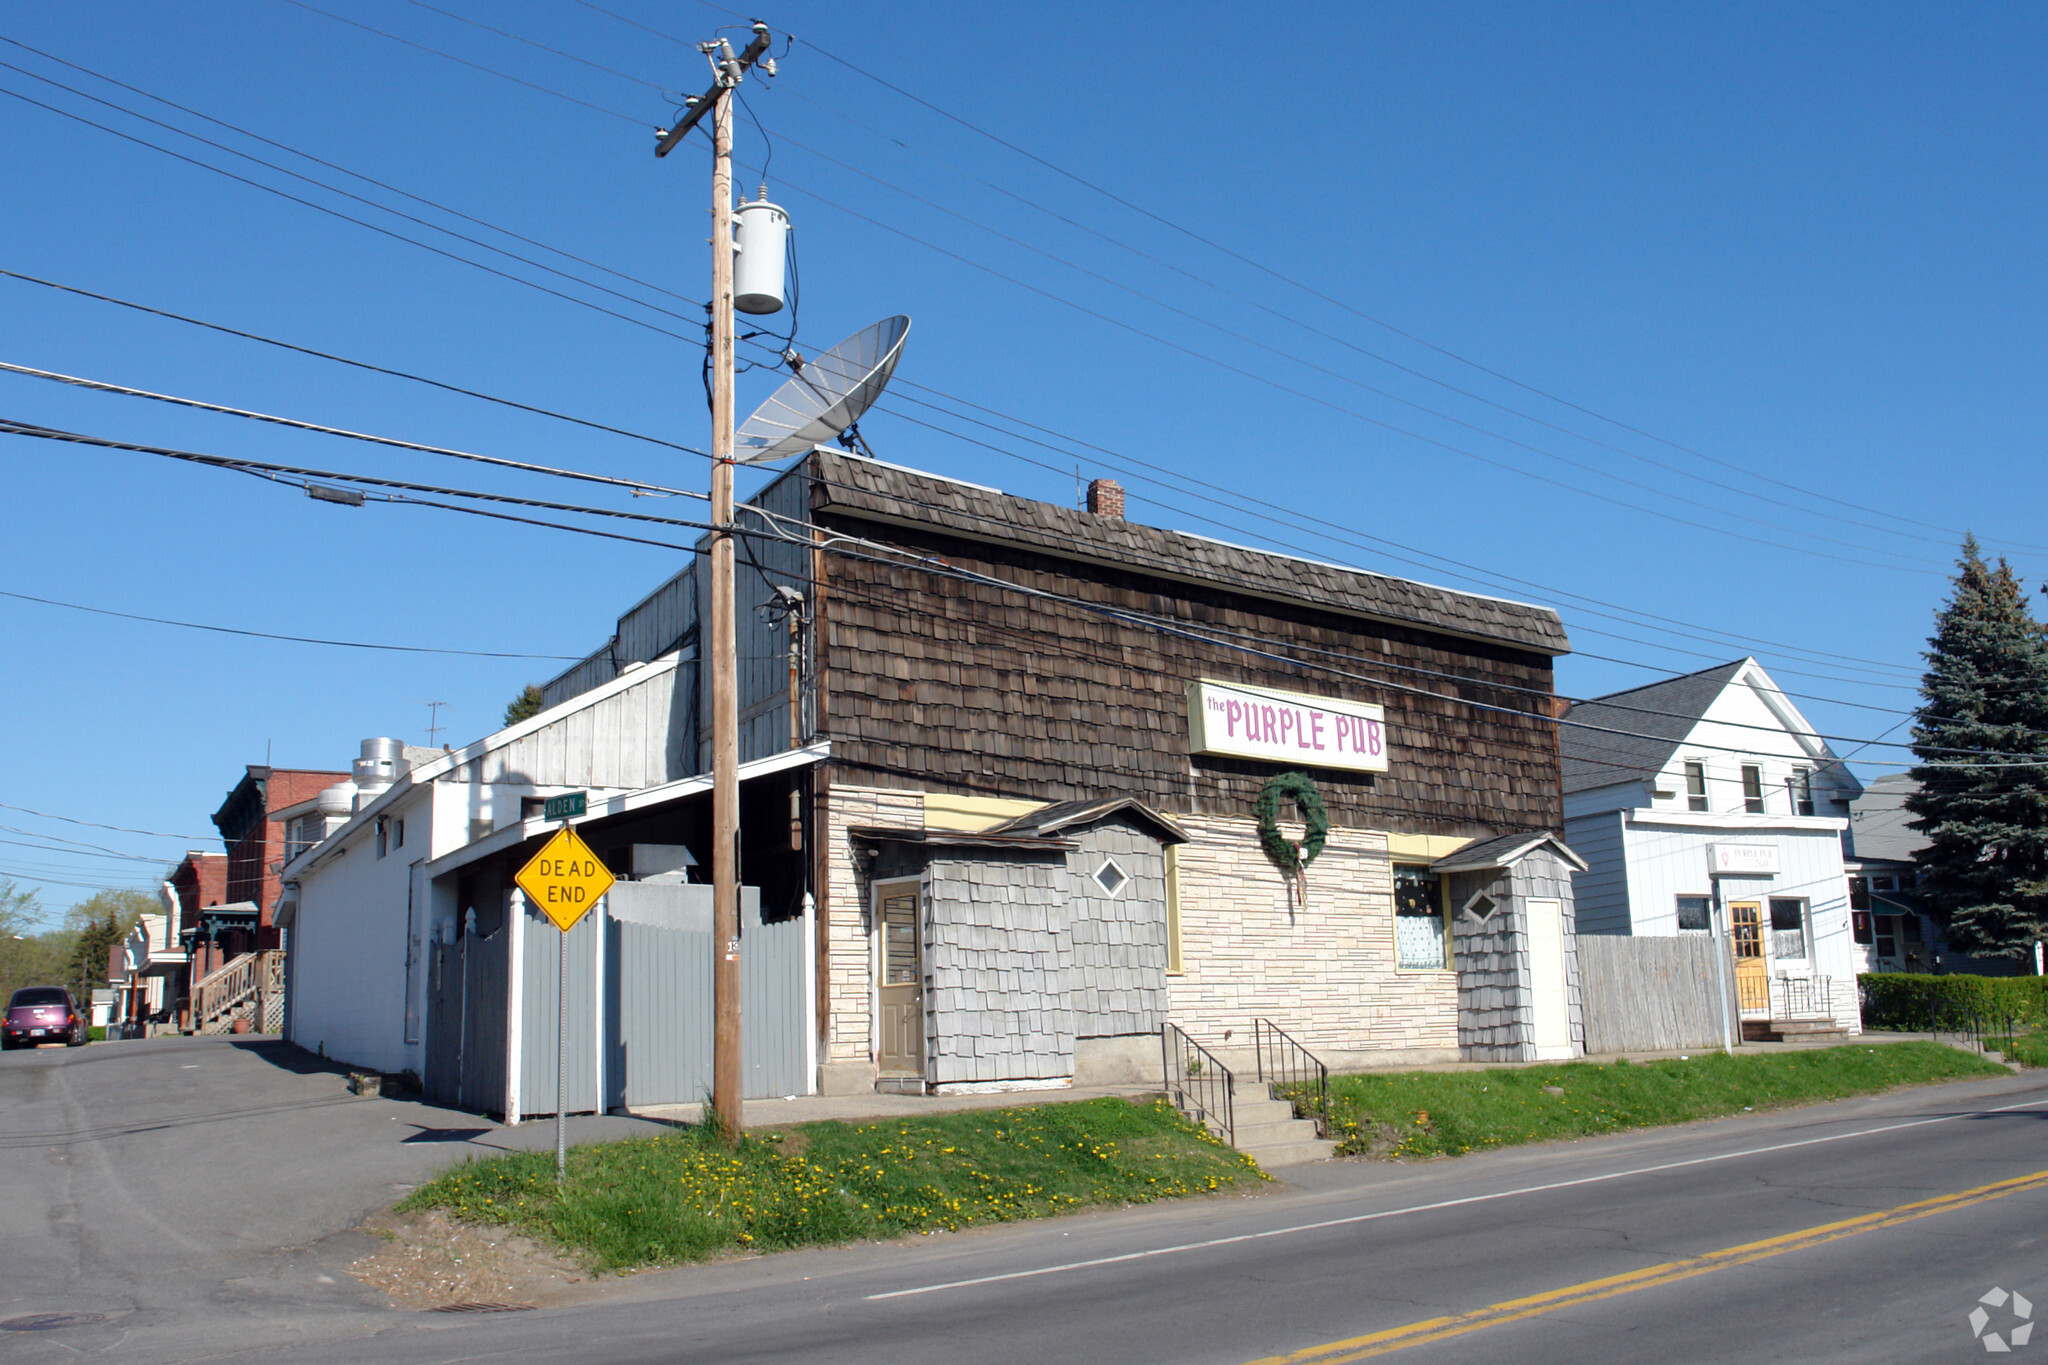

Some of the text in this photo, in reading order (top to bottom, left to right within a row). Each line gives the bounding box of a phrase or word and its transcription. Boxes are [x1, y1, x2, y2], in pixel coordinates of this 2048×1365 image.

[1207, 696, 1382, 756] the PURPLE PUB
[547, 797, 575, 816] ALDEN
[540, 860, 595, 877] DEAD
[548, 886, 585, 903] END
